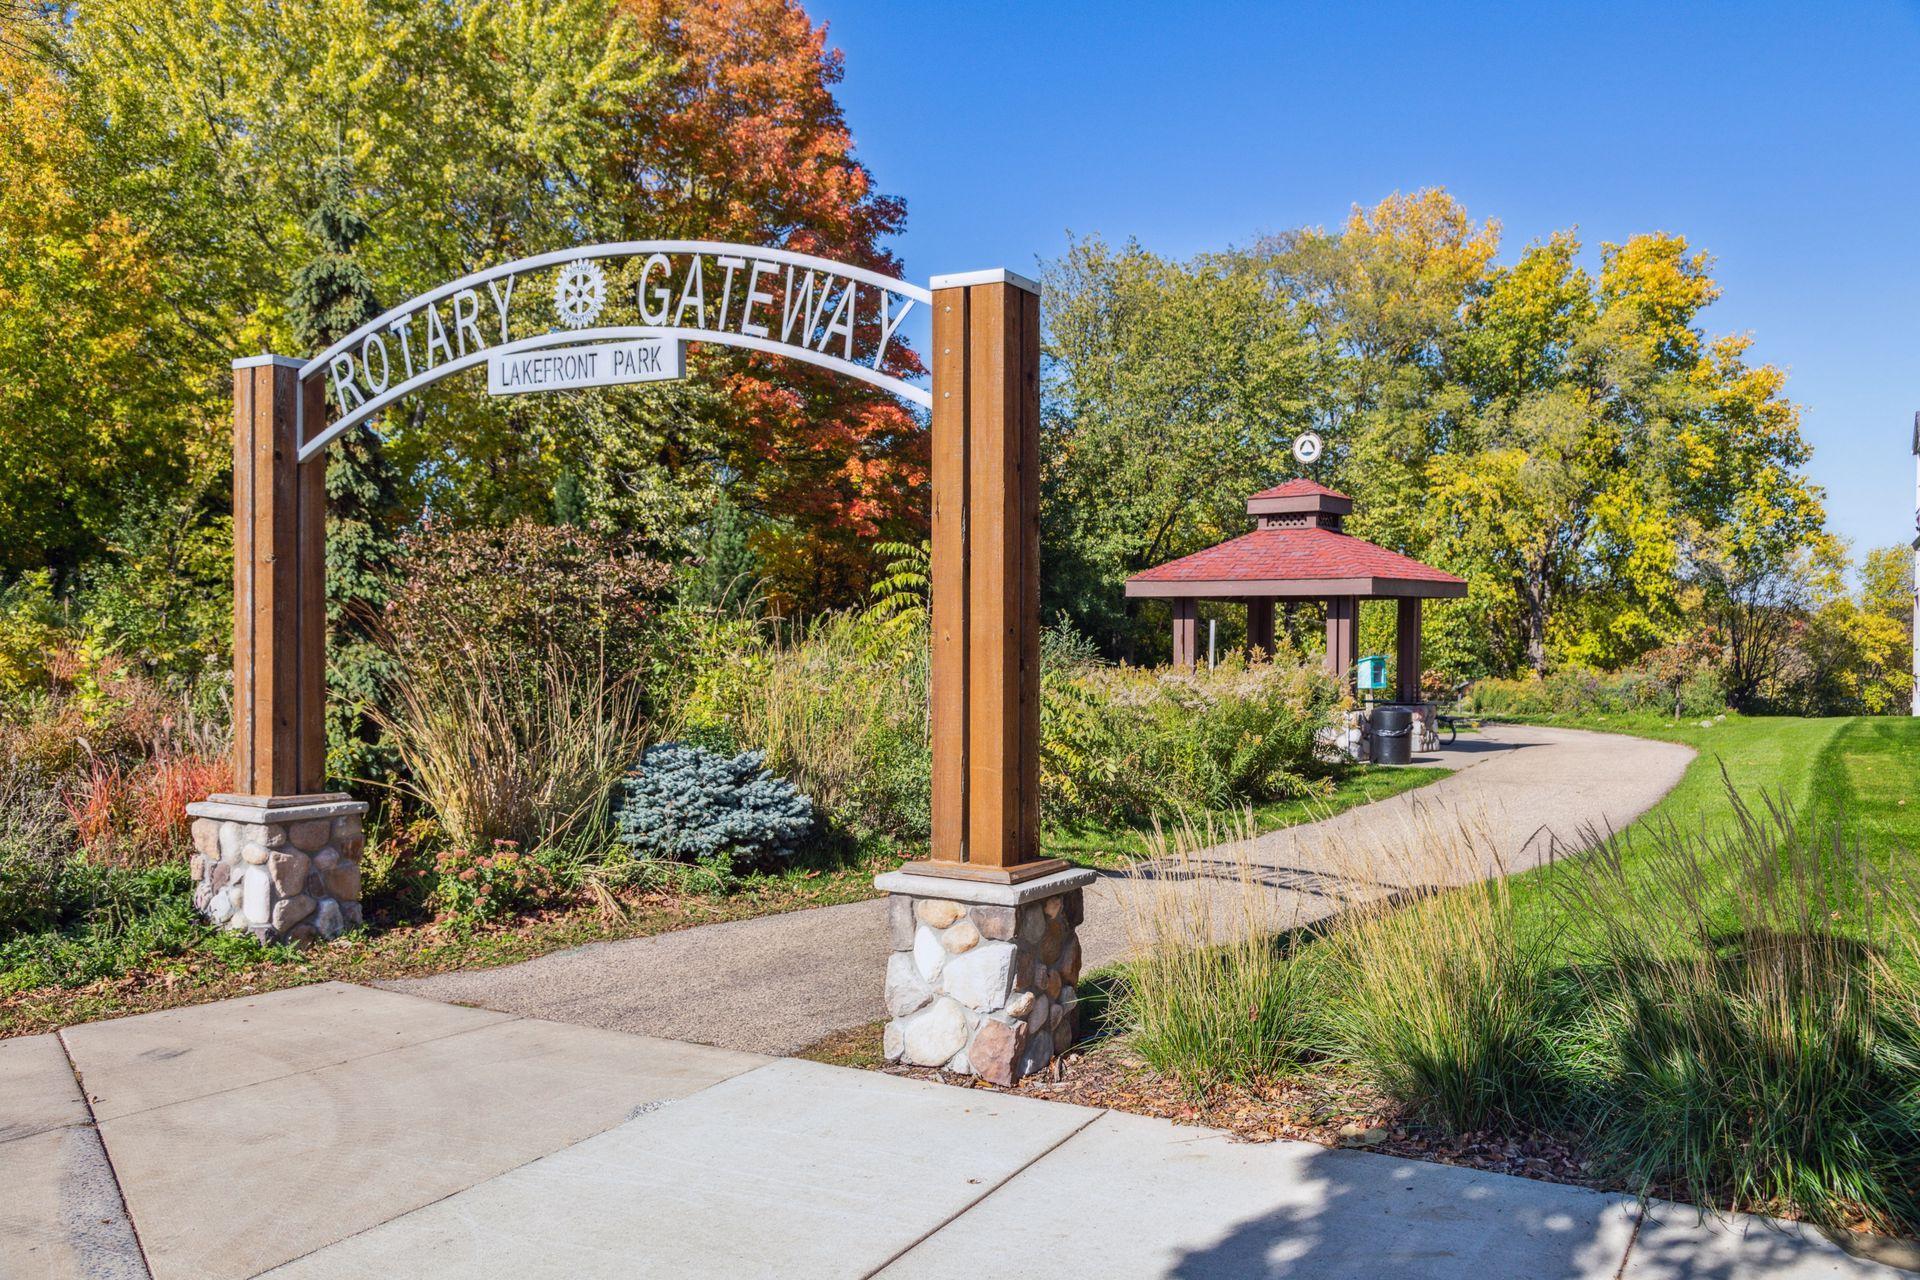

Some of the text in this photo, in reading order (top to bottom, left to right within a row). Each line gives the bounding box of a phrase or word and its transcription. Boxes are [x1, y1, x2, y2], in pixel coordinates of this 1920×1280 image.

[330, 254, 916, 415] ROTARY GATEWAY
[501, 345, 662, 387] LAKEFRONT PARK
